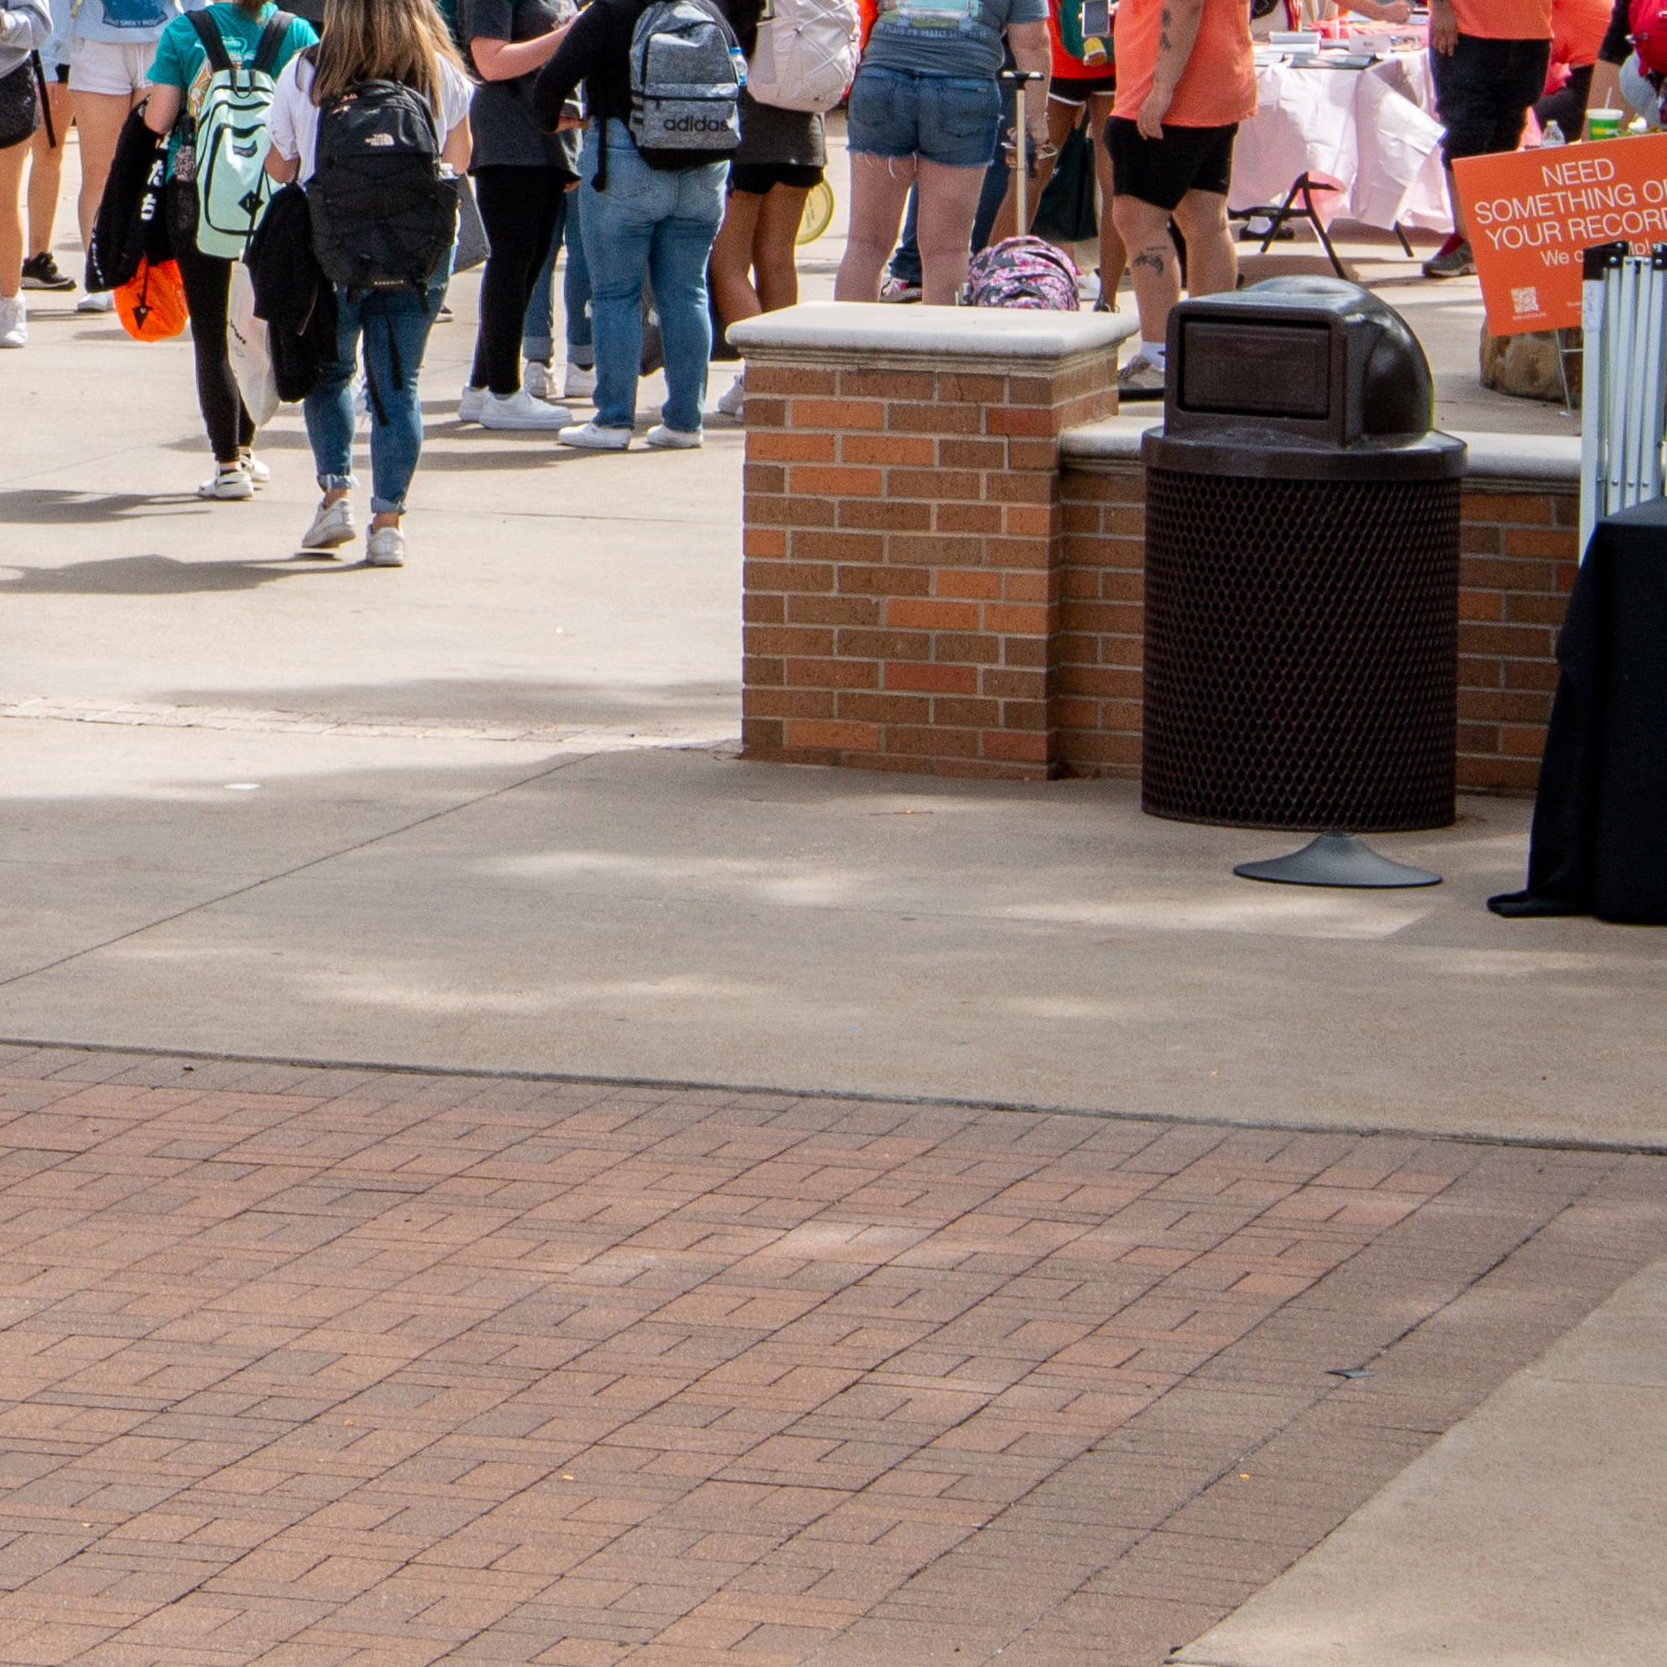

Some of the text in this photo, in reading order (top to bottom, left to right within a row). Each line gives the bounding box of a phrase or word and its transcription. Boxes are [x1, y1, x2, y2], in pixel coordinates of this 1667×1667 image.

[663, 113, 731, 132] adidas
[1541, 157, 1615, 188] NEED
[1474, 179, 1667, 225] SOMETHING O
[1485, 220, 1563, 251] YOUR
[1540, 249, 1570, 268] We
